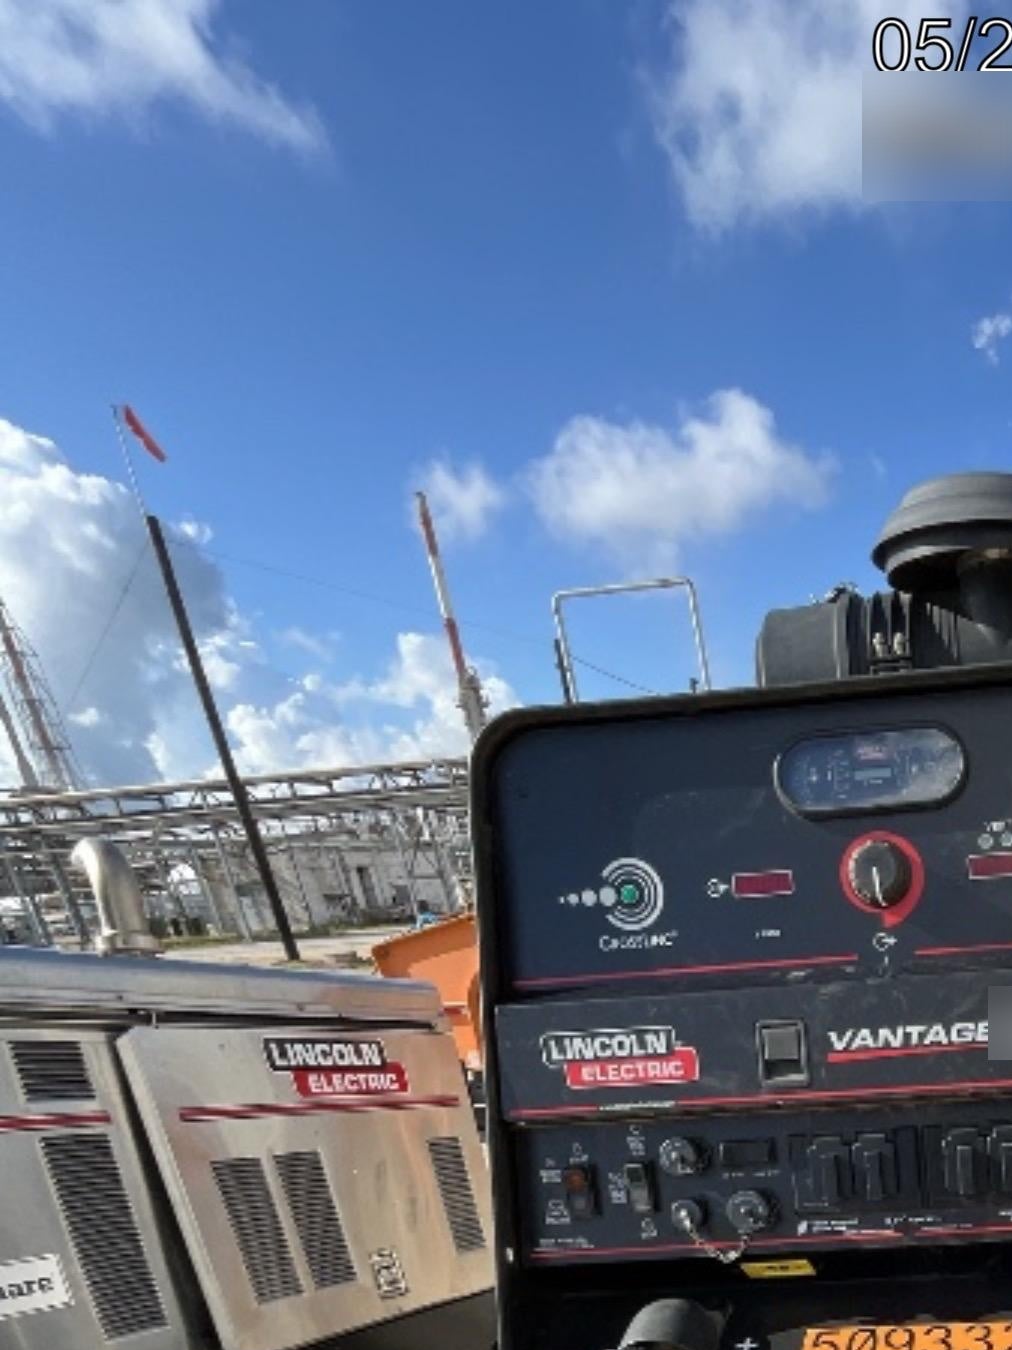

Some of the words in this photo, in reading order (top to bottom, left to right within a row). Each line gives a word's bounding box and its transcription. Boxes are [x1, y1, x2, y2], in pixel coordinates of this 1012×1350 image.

[269, 1043, 382, 1066] LINCOLN
[551, 1031, 667, 1061] LINCOLN
[581, 1060, 685, 1082] ELECTRIC
[308, 1073, 400, 1093] ELECTRIC
